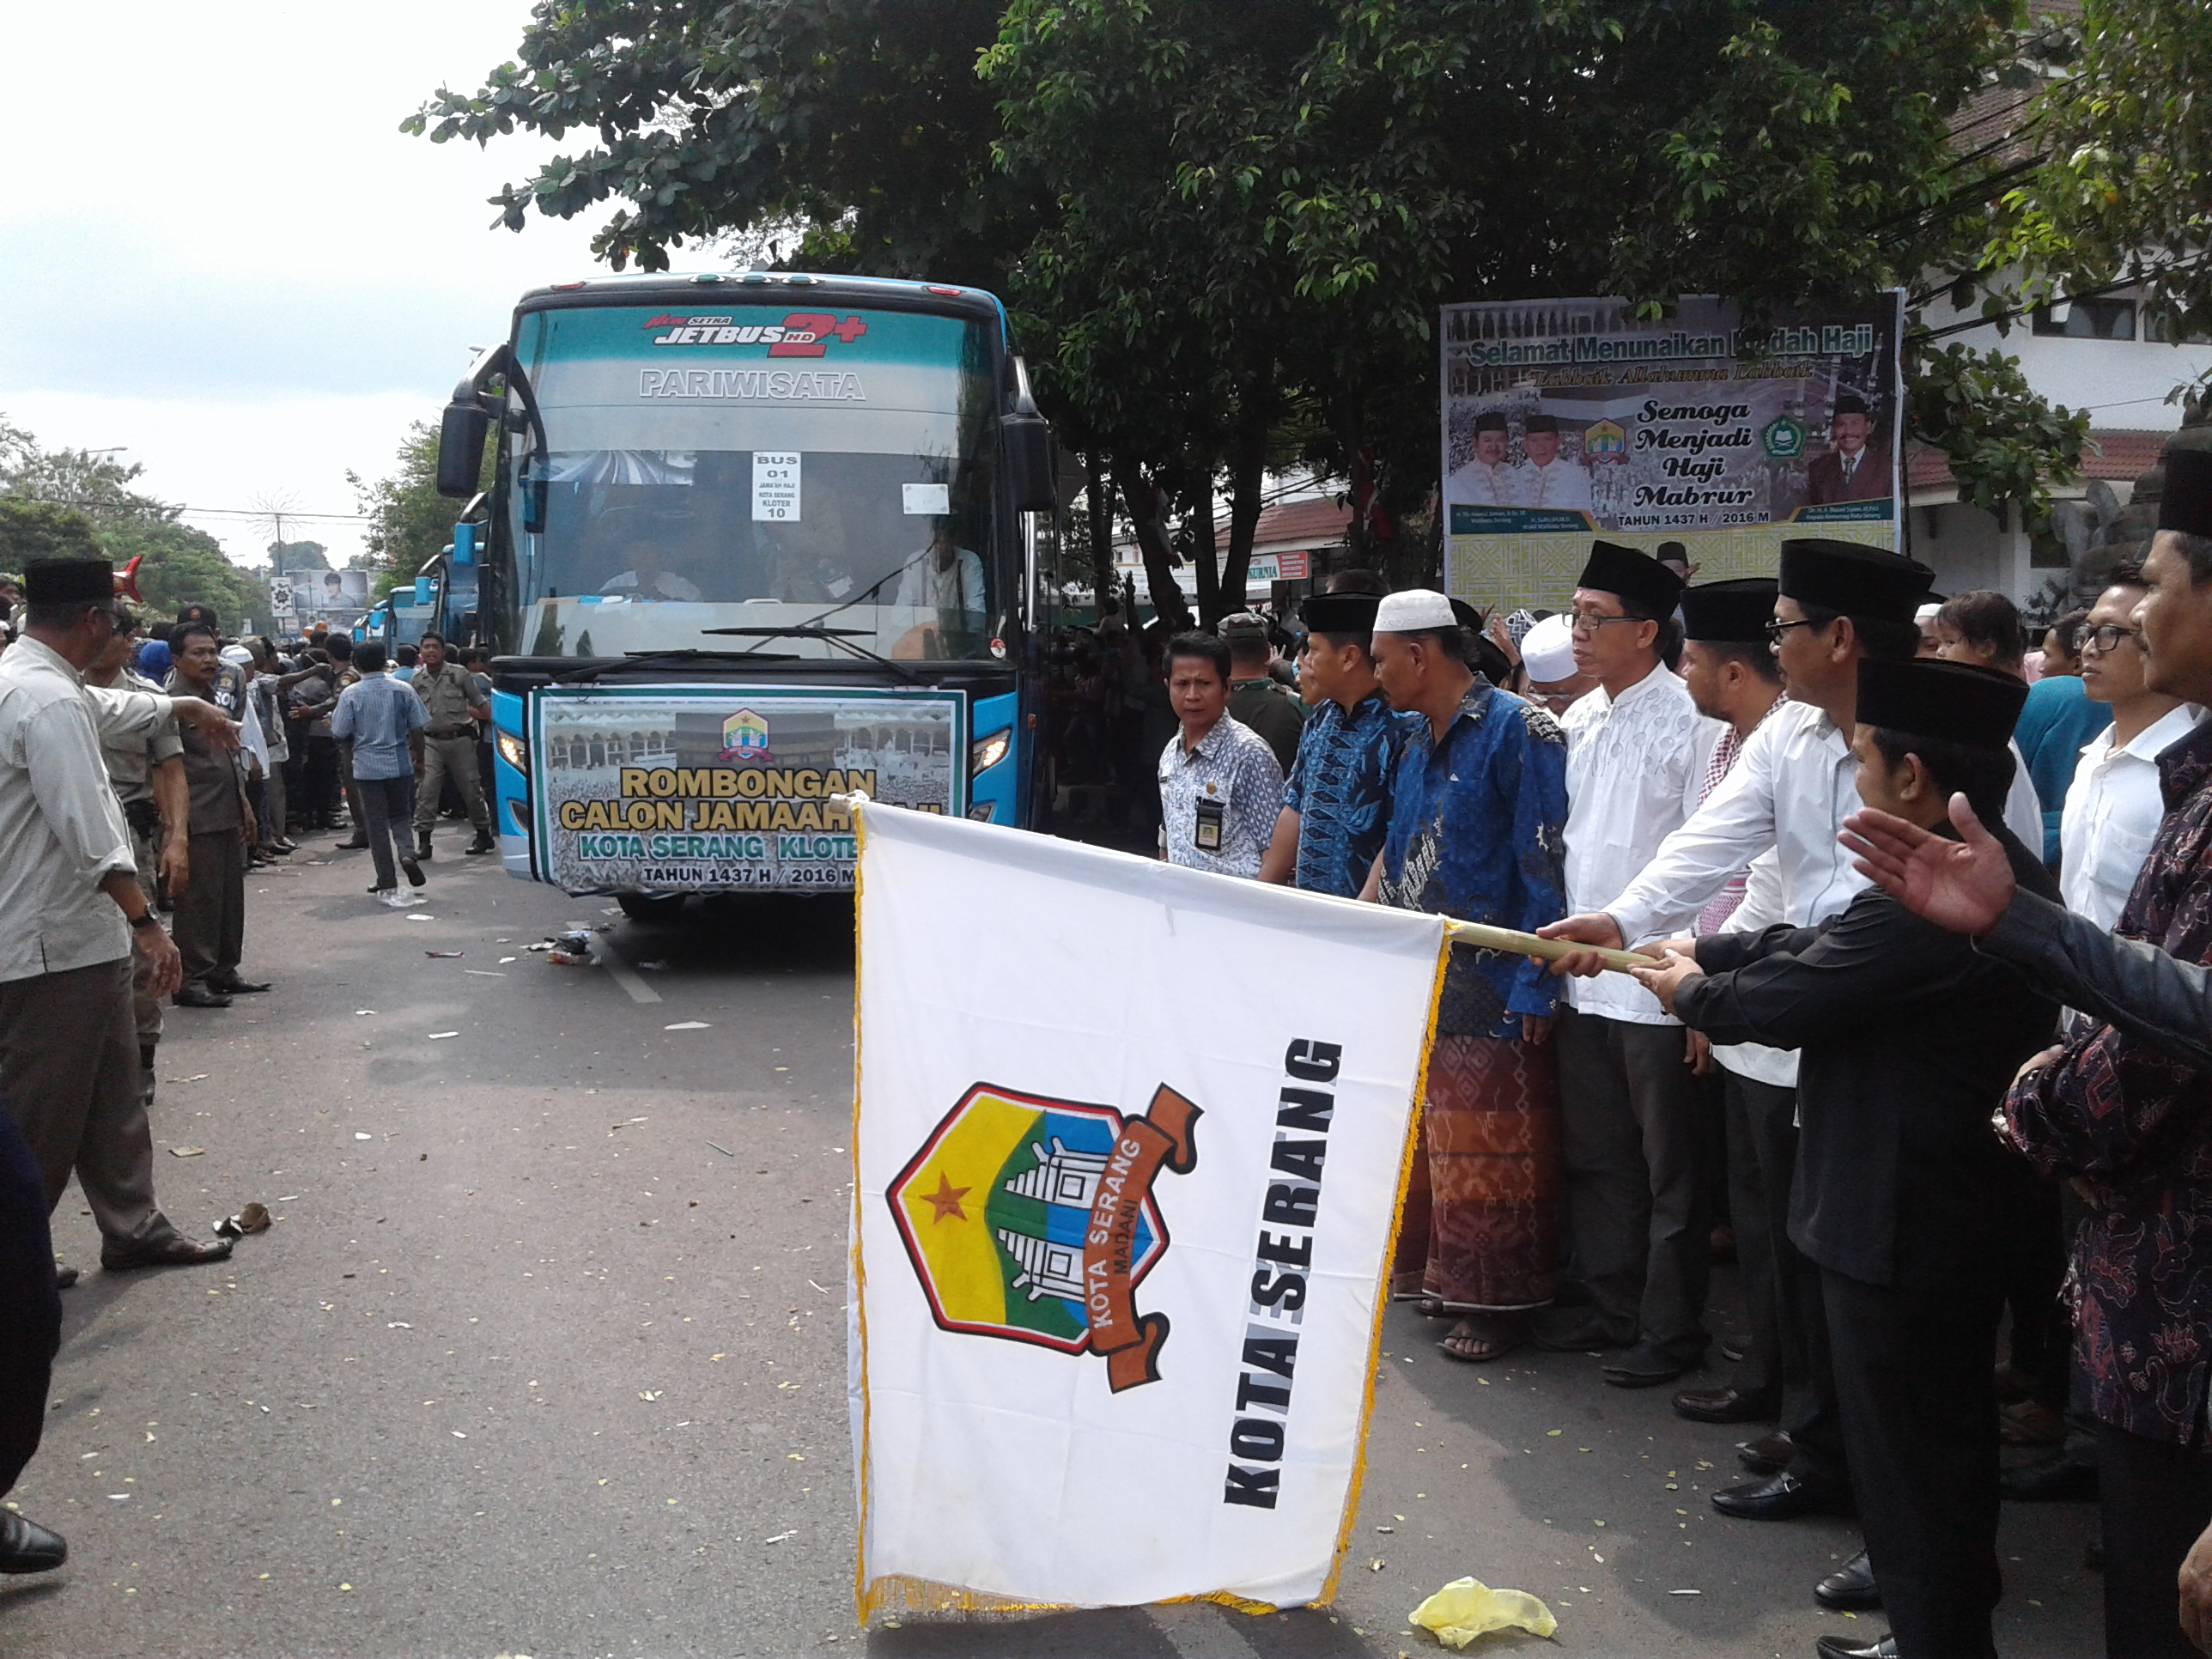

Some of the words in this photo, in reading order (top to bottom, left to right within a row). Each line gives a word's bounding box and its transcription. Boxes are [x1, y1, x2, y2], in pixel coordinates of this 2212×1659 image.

[654, 326, 786, 344] JETBUS
[787, 333, 814, 343] HD
[1469, 337, 1571, 366] Selamat
[1575, 331, 1726, 362] Menunaikan
[1730, 326, 1819, 357] Idah
[1822, 324, 1873, 358] Haji
[639, 368, 866, 401] PARIWISATA
[1637, 400, 1751, 426] Semoga
[1635, 428, 1753, 455] Menjadi
[757, 456, 798, 465] BUS
[1662, 457, 1725, 483] Haji
[767, 470, 788, 478] 01
[1633, 486, 1753, 507] Mabrur
[768, 508, 786, 519] 10
[1618, 515, 1660, 526] TAHUN
[1664, 514, 1696, 526] 1437
[1699, 514, 1709, 524] H
[1723, 513, 1755, 523] 2016
[1758, 513, 1770, 522] M
[620, 768, 876, 799] ROMBONGAN
[560, 800, 684, 830] CALON
[692, 801, 851, 832] JAMAAH
[579, 835, 646, 860] KOTA
[650, 835, 765, 860] SERANG
[778, 835, 858, 860] KLOTE
[644, 868, 702, 883] TAHUN
[709, 868, 752, 883] 1437
[759, 868, 772, 883] H
[792, 867, 836, 882] 2016
[842, 868, 856, 883] M
[1250, 1037, 1343, 1312] SERANG
[1089, 1139, 1141, 1245] SERANG
[1114, 1199, 1139, 1275] MADANI
[1088, 1259, 1113, 1329] KOTA
[1224, 1336, 1299, 1510] KOTA
